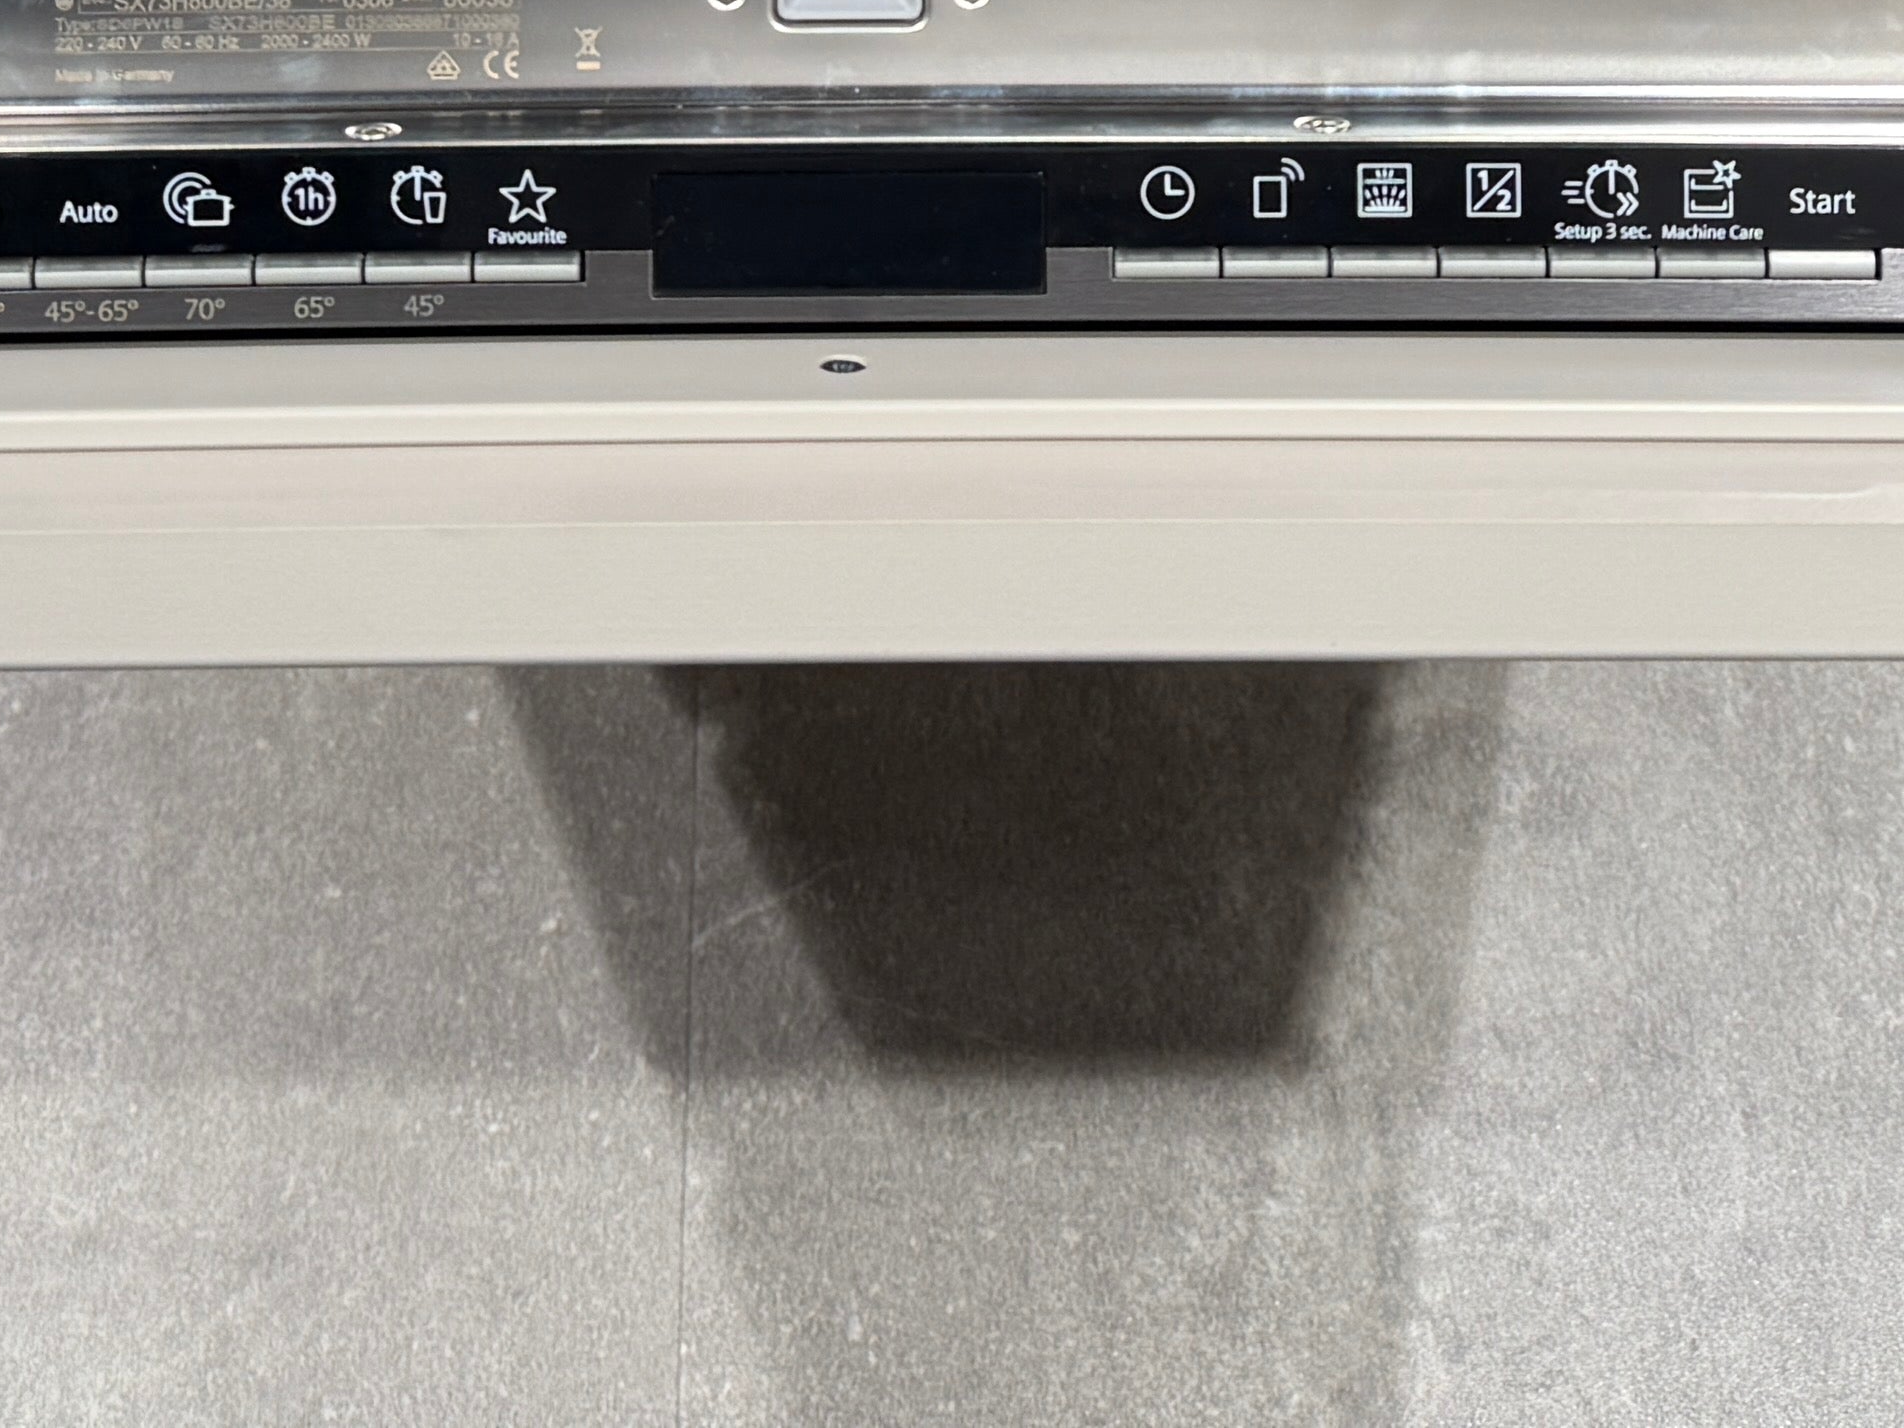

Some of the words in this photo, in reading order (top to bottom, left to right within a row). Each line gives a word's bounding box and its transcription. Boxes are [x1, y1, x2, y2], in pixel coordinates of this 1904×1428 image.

[54, 36, 84, 52] 220
[97, 36, 127, 51] 240
[128, 35, 143, 51] V
[217, 34, 240, 50] Hz
[312, 33, 350, 49] 2400
[352, 33, 372, 48] W
[453, 32, 472, 49] 10
[506, 31, 520, 49] A
[293, 185, 327, 212] 1h
[1788, 188, 1856, 216] Start
[59, 199, 119, 224] Auto
[487, 226, 568, 246] Favourite
[1554, 222, 1603, 244] Setup
[1606, 222, 1618, 240] 3
[1620, 222, 1652, 240] sec.
[1661, 221, 1726, 241] Machine
[1728, 222, 1764, 241] Care
[183, 296, 227, 321] 70°
[293, 294, 337, 320] 65°
[404, 291, 446, 318] 45°
